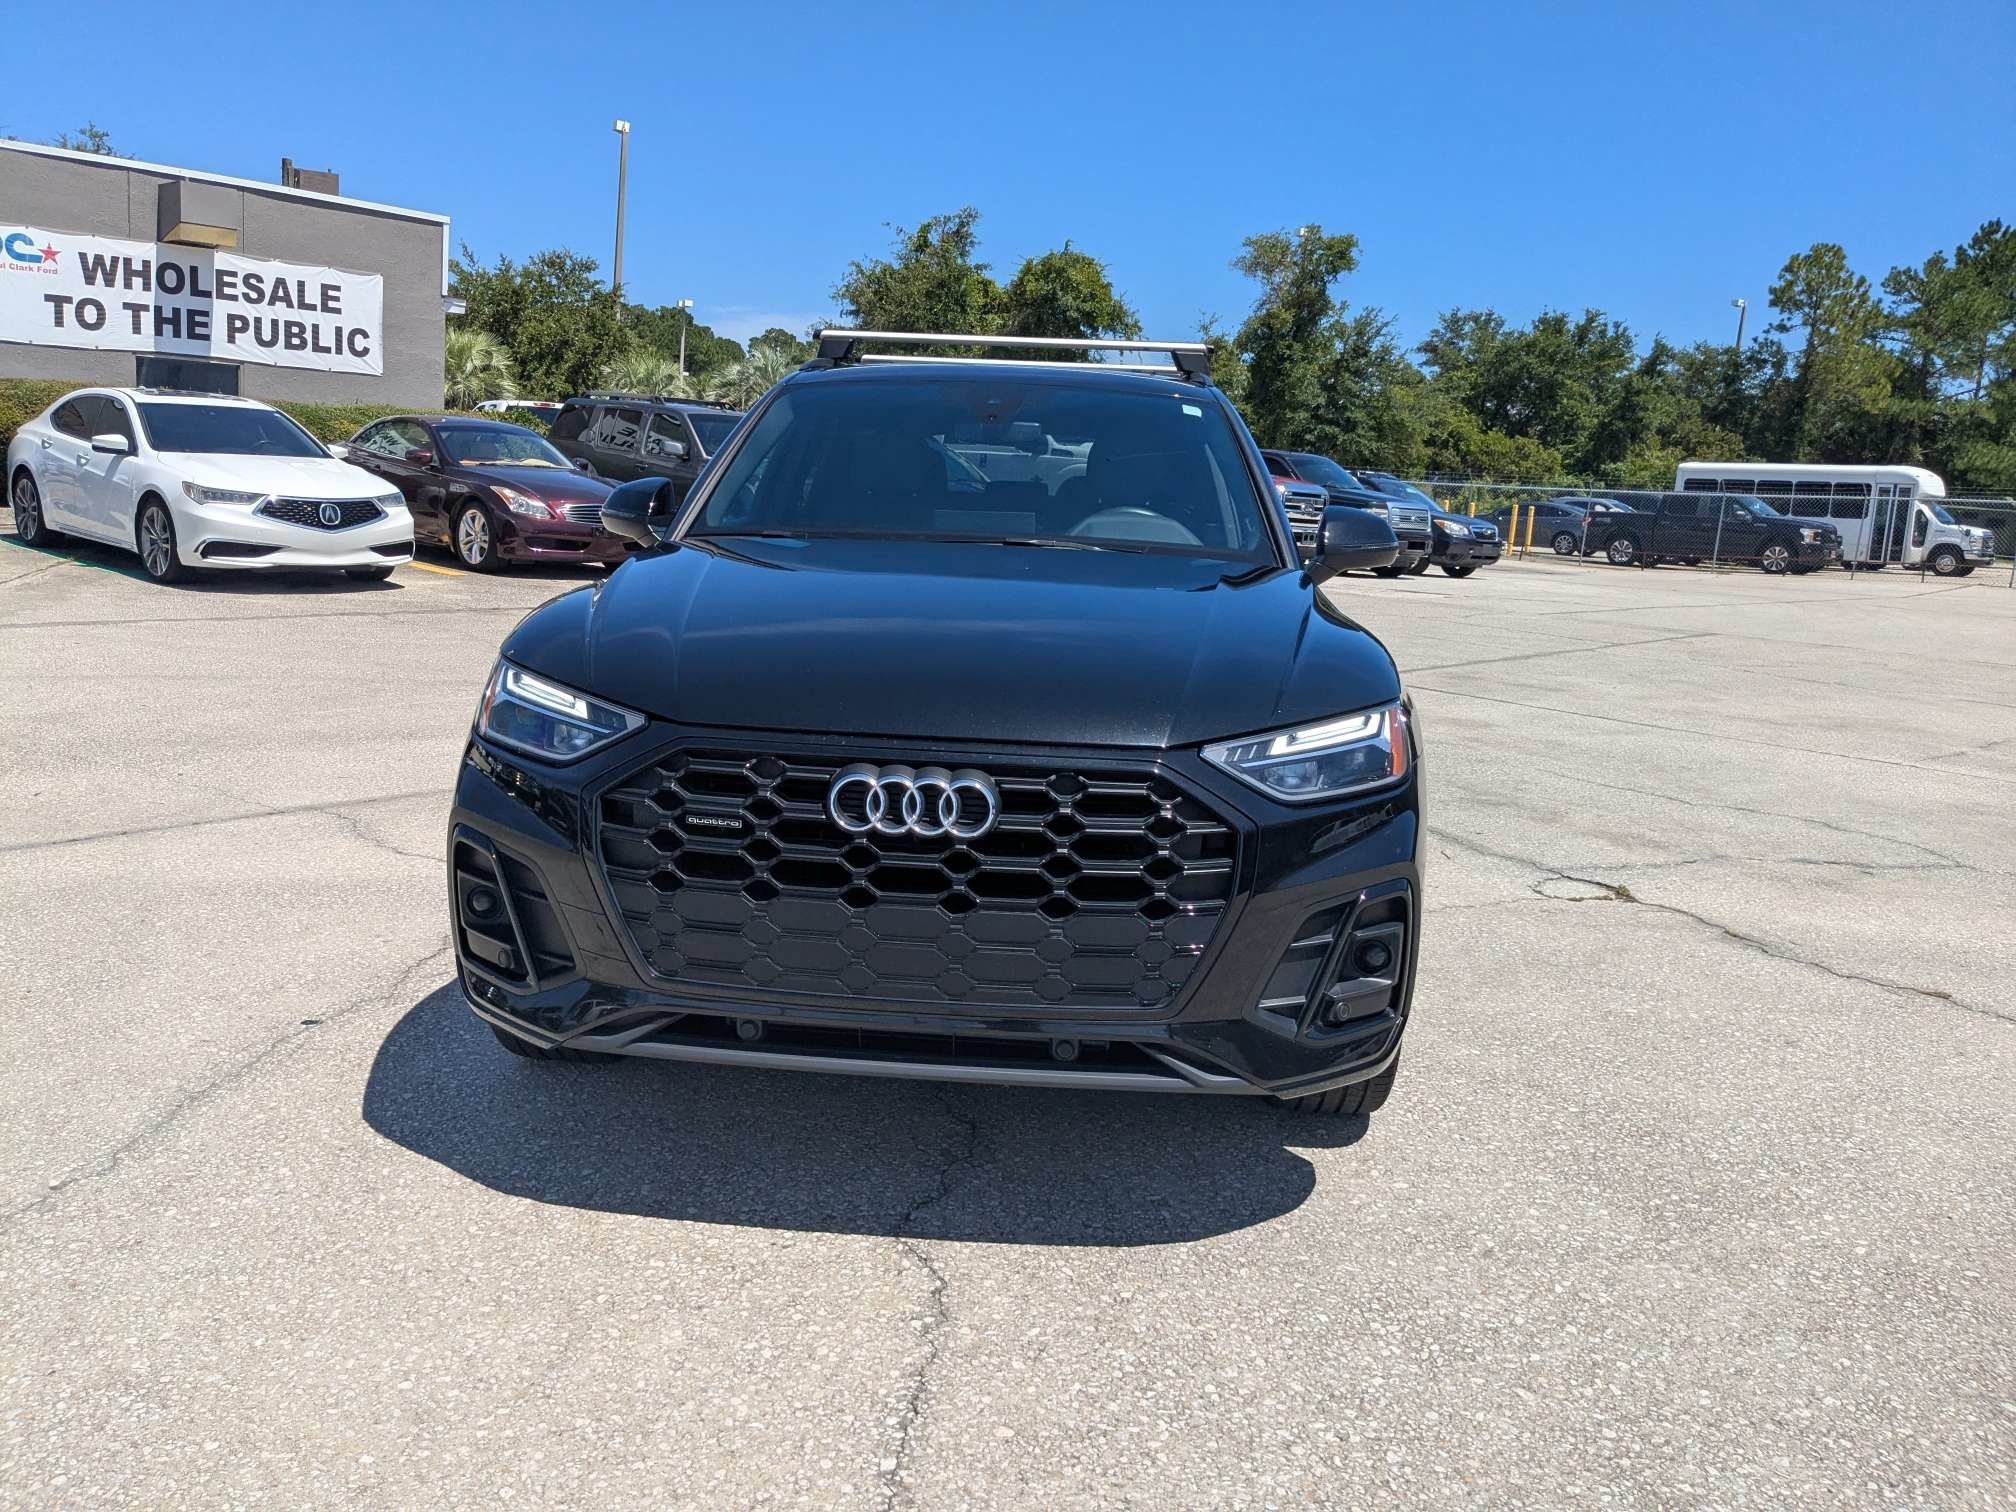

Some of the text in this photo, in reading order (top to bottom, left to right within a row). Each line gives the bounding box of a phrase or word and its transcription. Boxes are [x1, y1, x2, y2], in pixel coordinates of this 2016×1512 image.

[9, 263, 34, 272] Clark
[37, 266, 58, 275] Ford
[78, 251, 342, 314] WHOLESALE
[44, 294, 371, 358] TO THE PUBLIC
[688, 817, 739, 826] quattro
